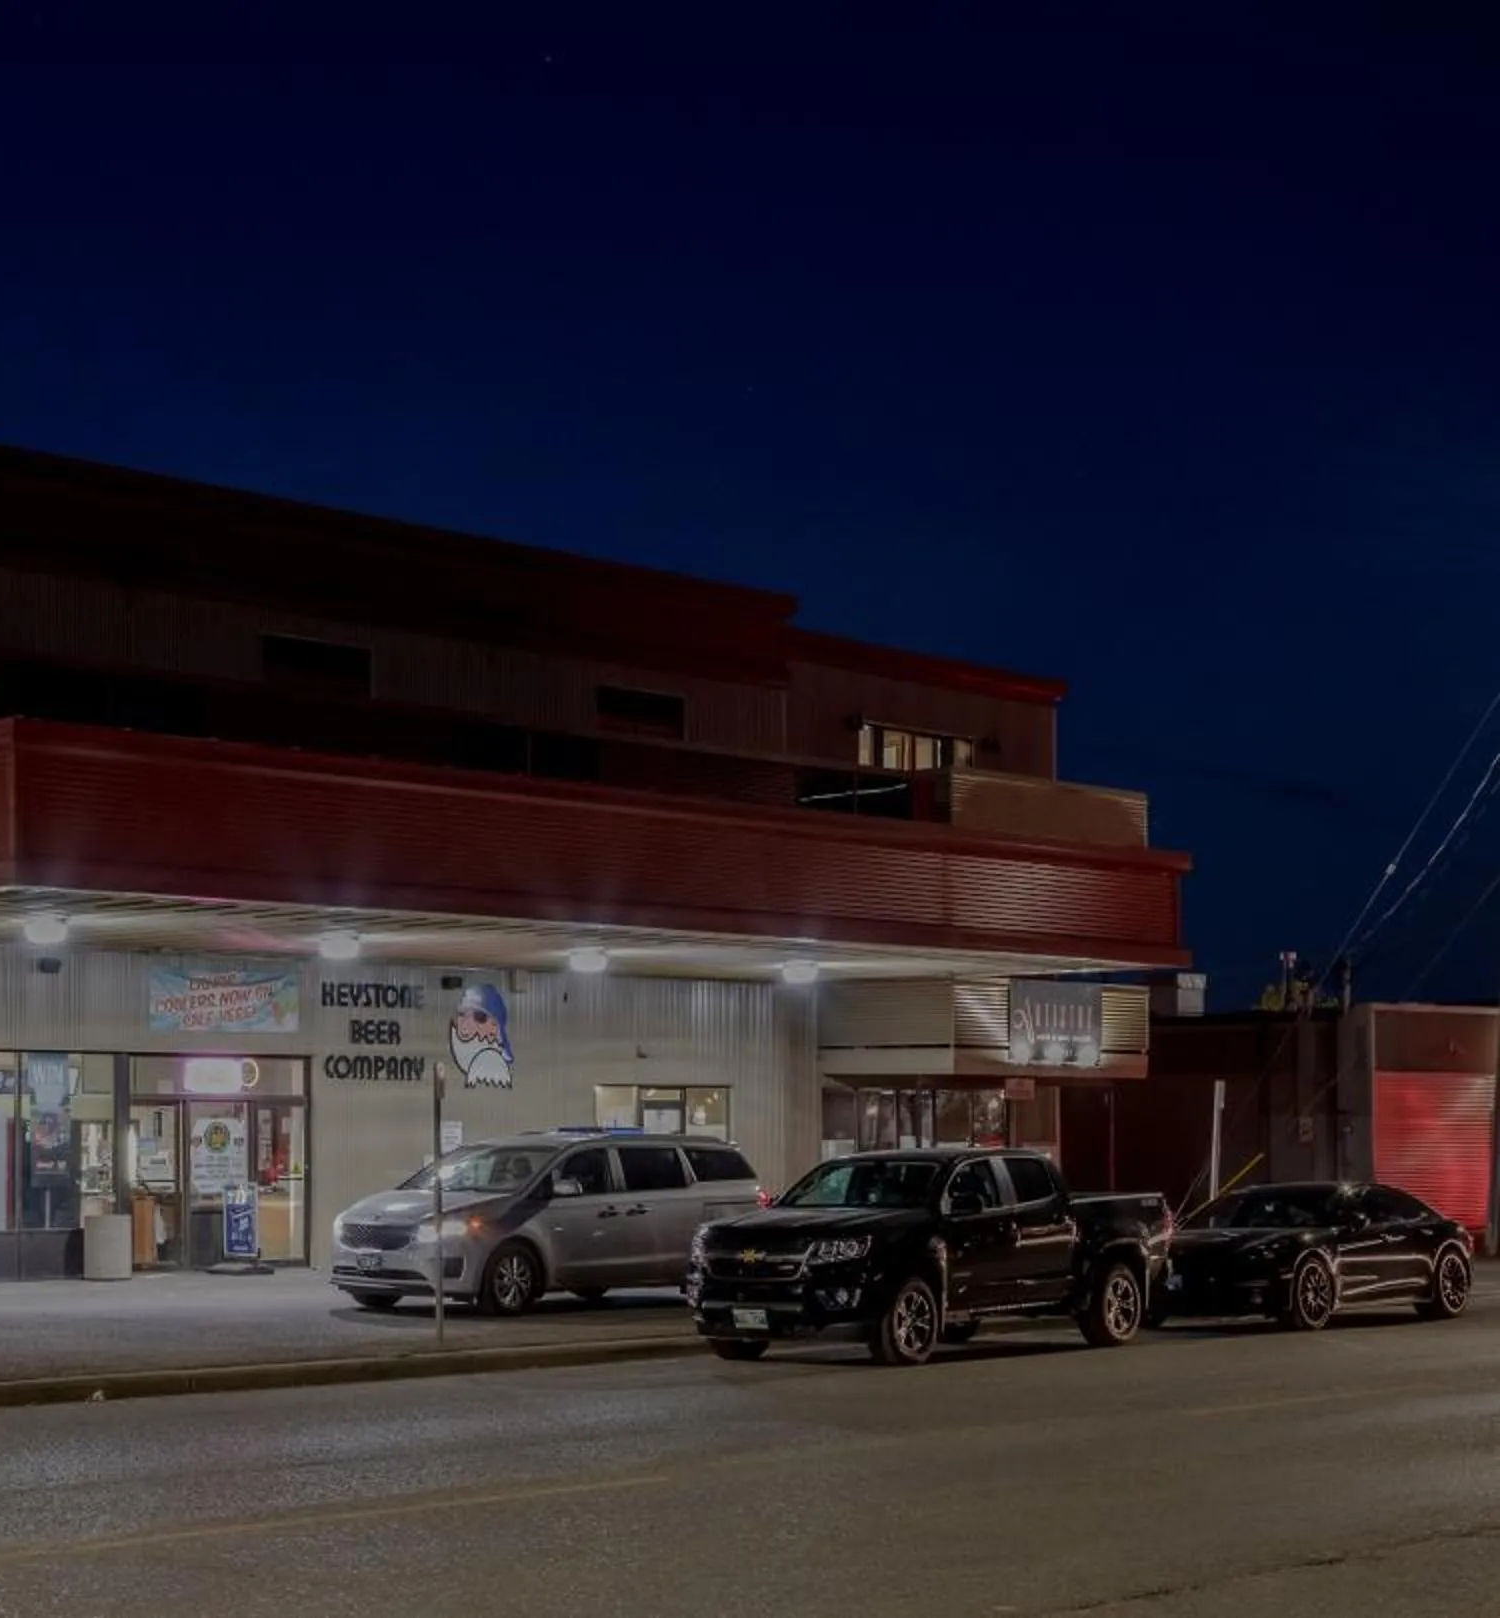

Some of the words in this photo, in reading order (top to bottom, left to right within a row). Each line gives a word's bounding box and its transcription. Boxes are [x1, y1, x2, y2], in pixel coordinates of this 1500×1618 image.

[322, 982, 425, 1010] KEYSTONE
[351, 1019, 402, 1045] BEER
[325, 1054, 425, 1081] COMPANY
